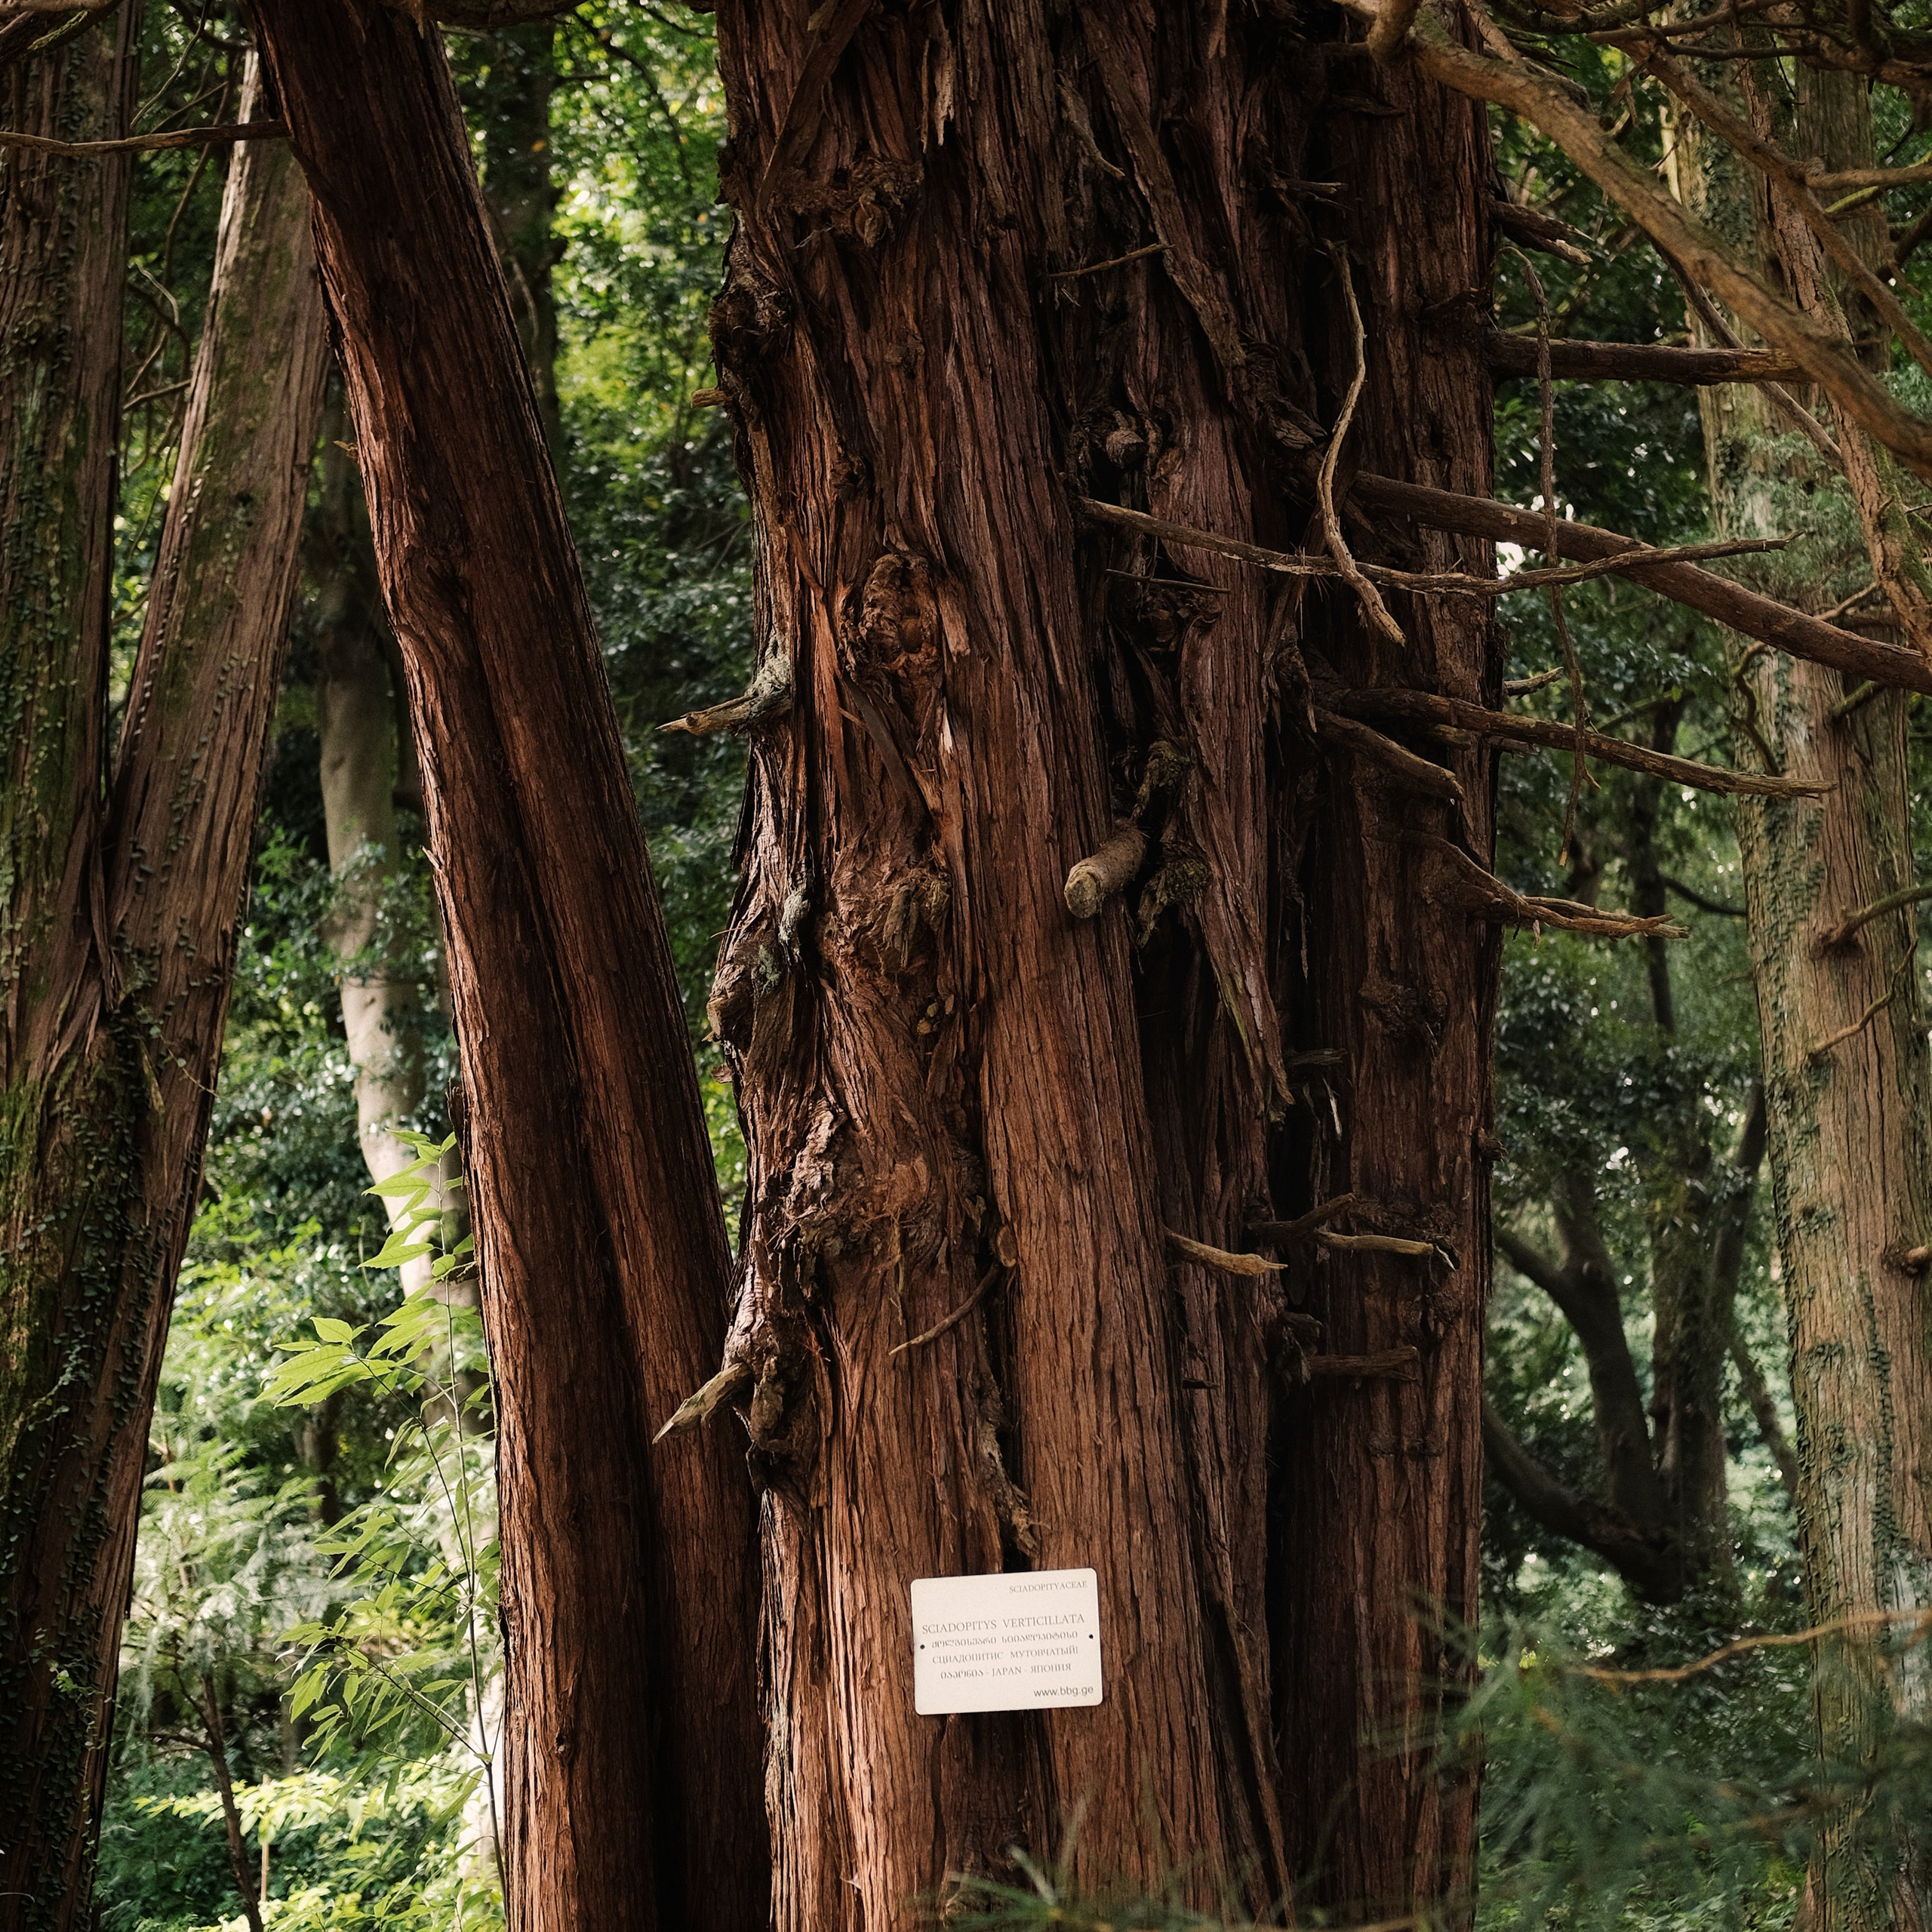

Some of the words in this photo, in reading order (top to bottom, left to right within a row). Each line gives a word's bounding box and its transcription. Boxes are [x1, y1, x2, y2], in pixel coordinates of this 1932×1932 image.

[1009, 1580, 1088, 1593] SCIADOPITYACEAE
[921, 1620, 997, 1635] SCIADOPITYS
[1002, 1613, 1085, 1629] VERTICILLATA
[932, 1651, 1003, 1665] СЦИАДОПИТИС
[992, 1666, 1022, 1678] JAPAN
[1030, 1663, 1072, 1673] ЯПОНИЯ
[1032, 1685, 1094, 1698] www.bbg.ge
